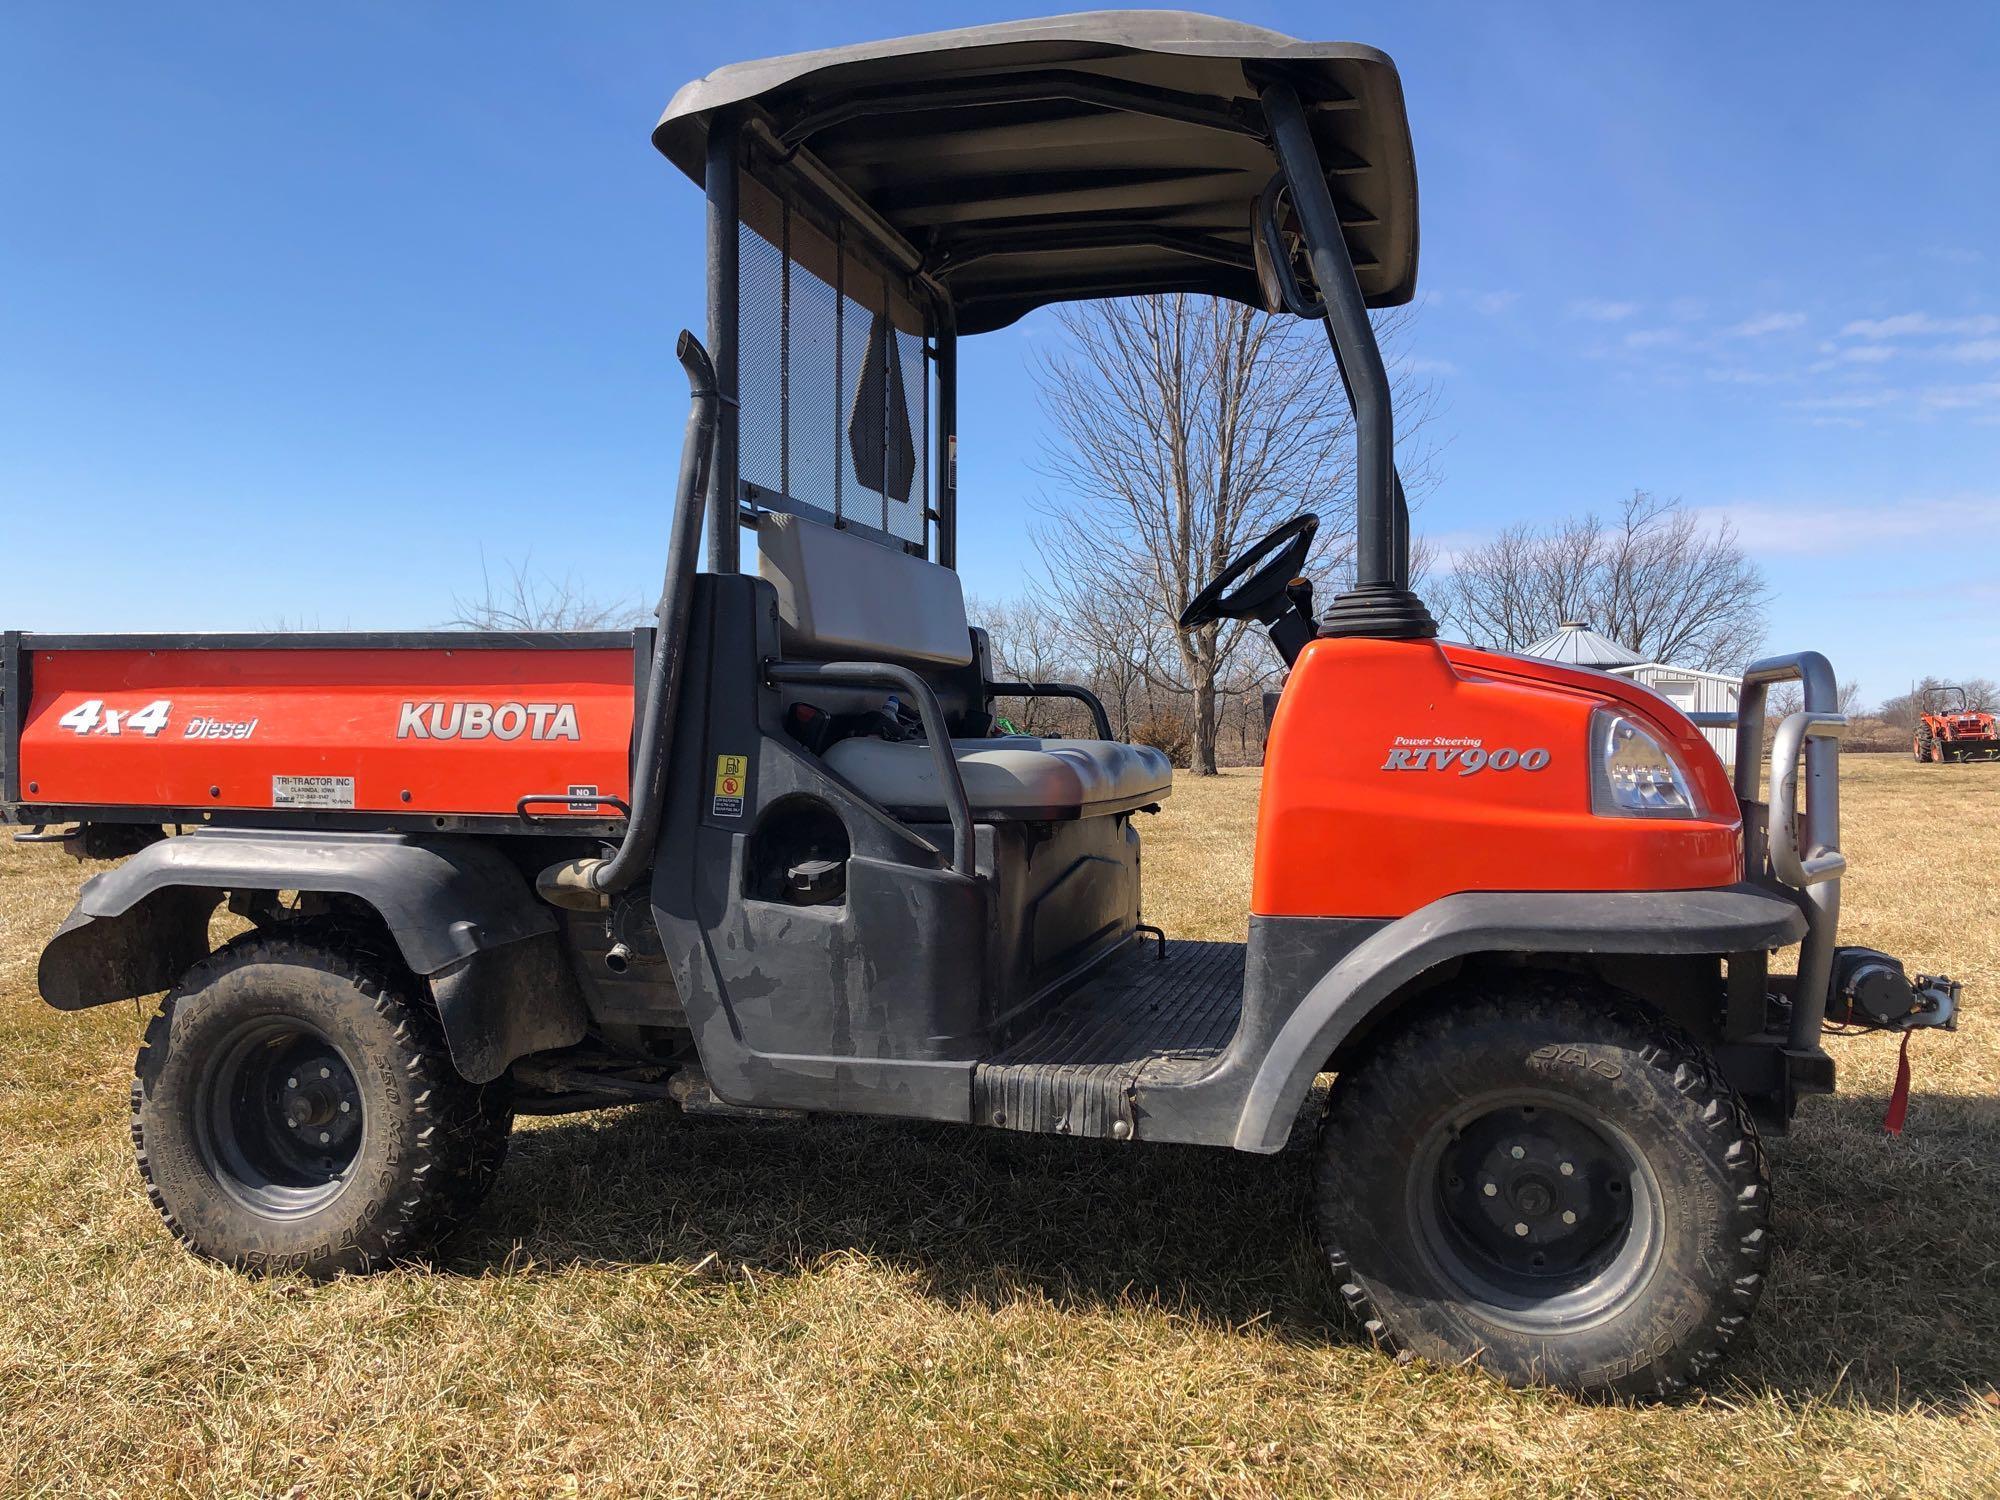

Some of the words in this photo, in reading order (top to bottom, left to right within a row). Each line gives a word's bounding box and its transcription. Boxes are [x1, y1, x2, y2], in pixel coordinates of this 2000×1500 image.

[59, 699, 174, 737] 4x4
[184, 717, 259, 739] Diesel
[396, 702, 580, 740] KUBOTA
[1394, 736, 1432, 746] Power
[1432, 736, 1482, 748] Steering
[1381, 748, 1551, 777] RTV900
[277, 777, 332, 786] TRI-TRACTOR
[336, 778, 350, 786] INC
